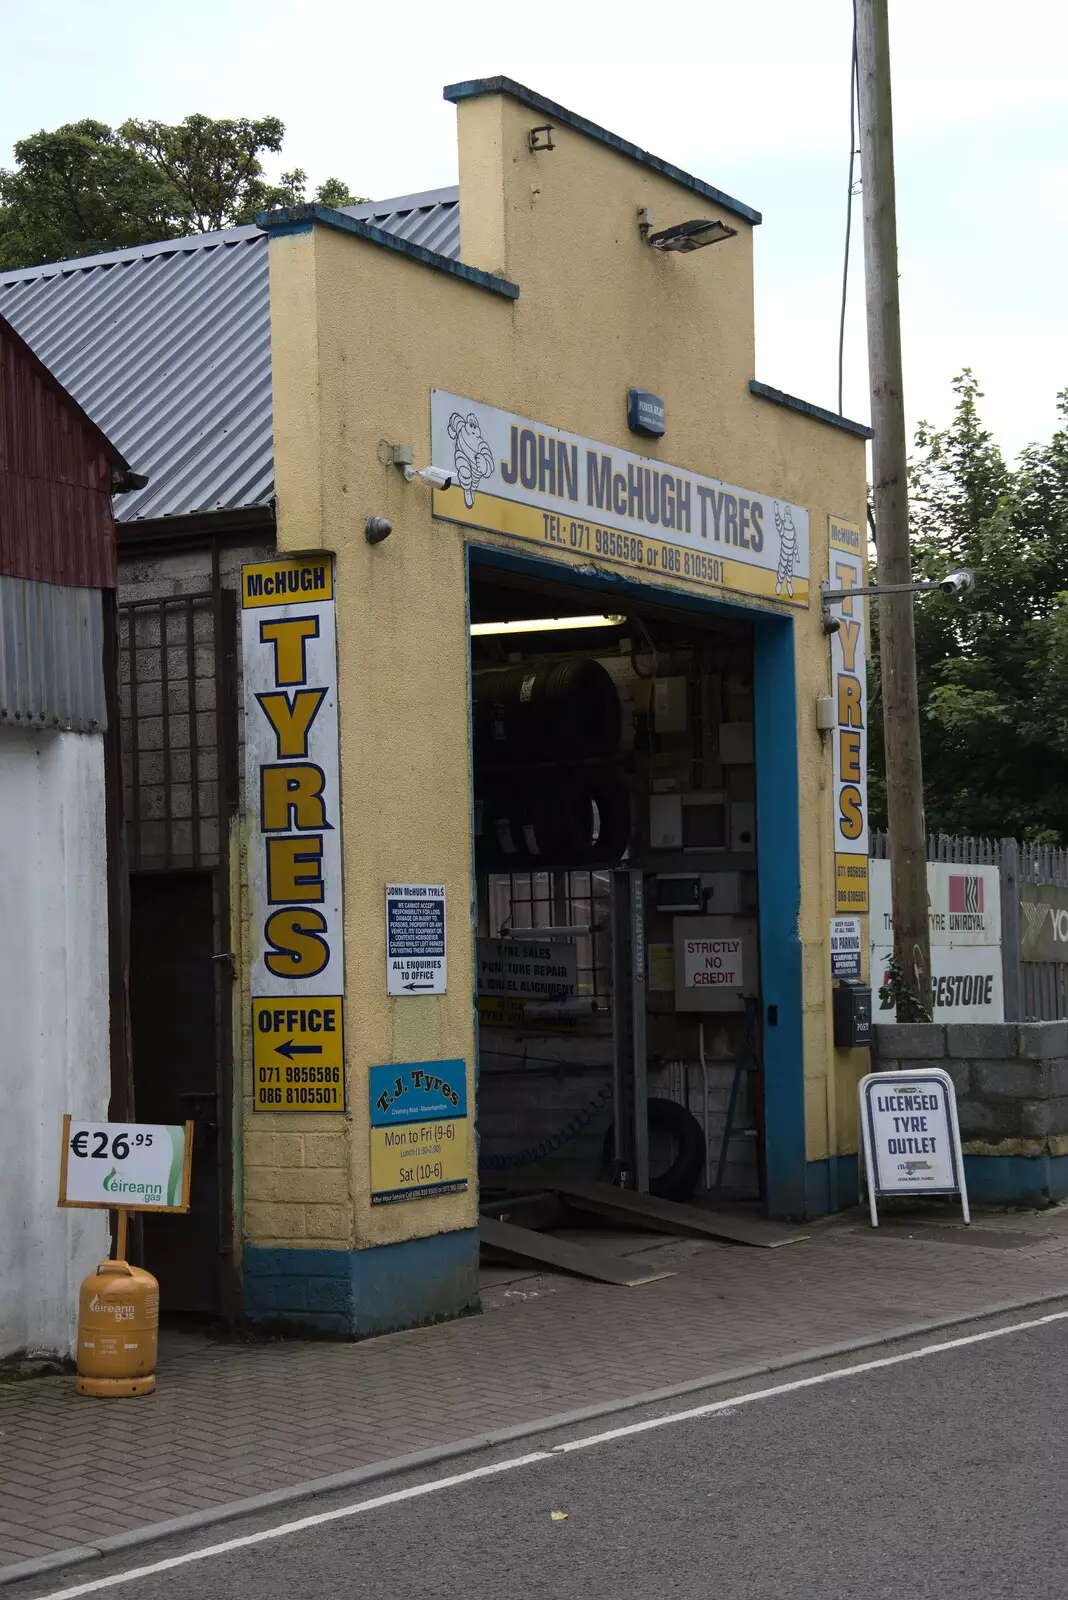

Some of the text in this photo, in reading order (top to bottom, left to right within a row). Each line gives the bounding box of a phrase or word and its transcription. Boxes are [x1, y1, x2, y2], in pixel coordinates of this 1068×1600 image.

[500, 424, 764, 554] JOHN McHUGH TYRES
[831, 524, 859, 549] McHUGH
[543, 514, 724, 584] TEL: 071 9856586 or 086 8105501
[247, 567, 326, 598] McHUGH
[835, 561, 865, 841] TYRES
[254, 614, 336, 980] TYRES
[838, 866, 866, 878] 071 9856586
[387, 888, 444, 896] JOHN McHUGH TYRES
[838, 890, 846, 902] 086
[883, 913, 893, 930] TH
[949, 914, 985, 931] UNIROYAL
[687, 942, 740, 954] STRICTLY
[831, 936, 859, 950] NO PARKING
[523, 947, 552, 959] SALES
[392, 960, 442, 970] ALL ENQUIRIES
[534, 964, 568, 978] REPAIR
[705, 957, 722, 969] NO
[401, 972, 434, 980] TO OFFICE
[694, 972, 735, 984] CREDIT
[258, 1010, 336, 1032] OFFICE
[857, 1022, 869, 1032] POST
[259, 1067, 340, 1083] 071 9856586
[411, 1069, 460, 1106] Tyres
[259, 1088, 337, 1104] 086 8105501
[878, 1094, 938, 1112] LICENSED
[893, 1116, 928, 1133] TYRE
[385, 1124, 455, 1146] Mon to Fri (9-6)
[400, 1149, 415, 1158] Lunch
[888, 1138, 936, 1154] OUTLET
[400, 1161, 443, 1183] Sat (10-6)
[110, 1180, 162, 1194] éireann
[144, 1193, 161, 1203] gas
